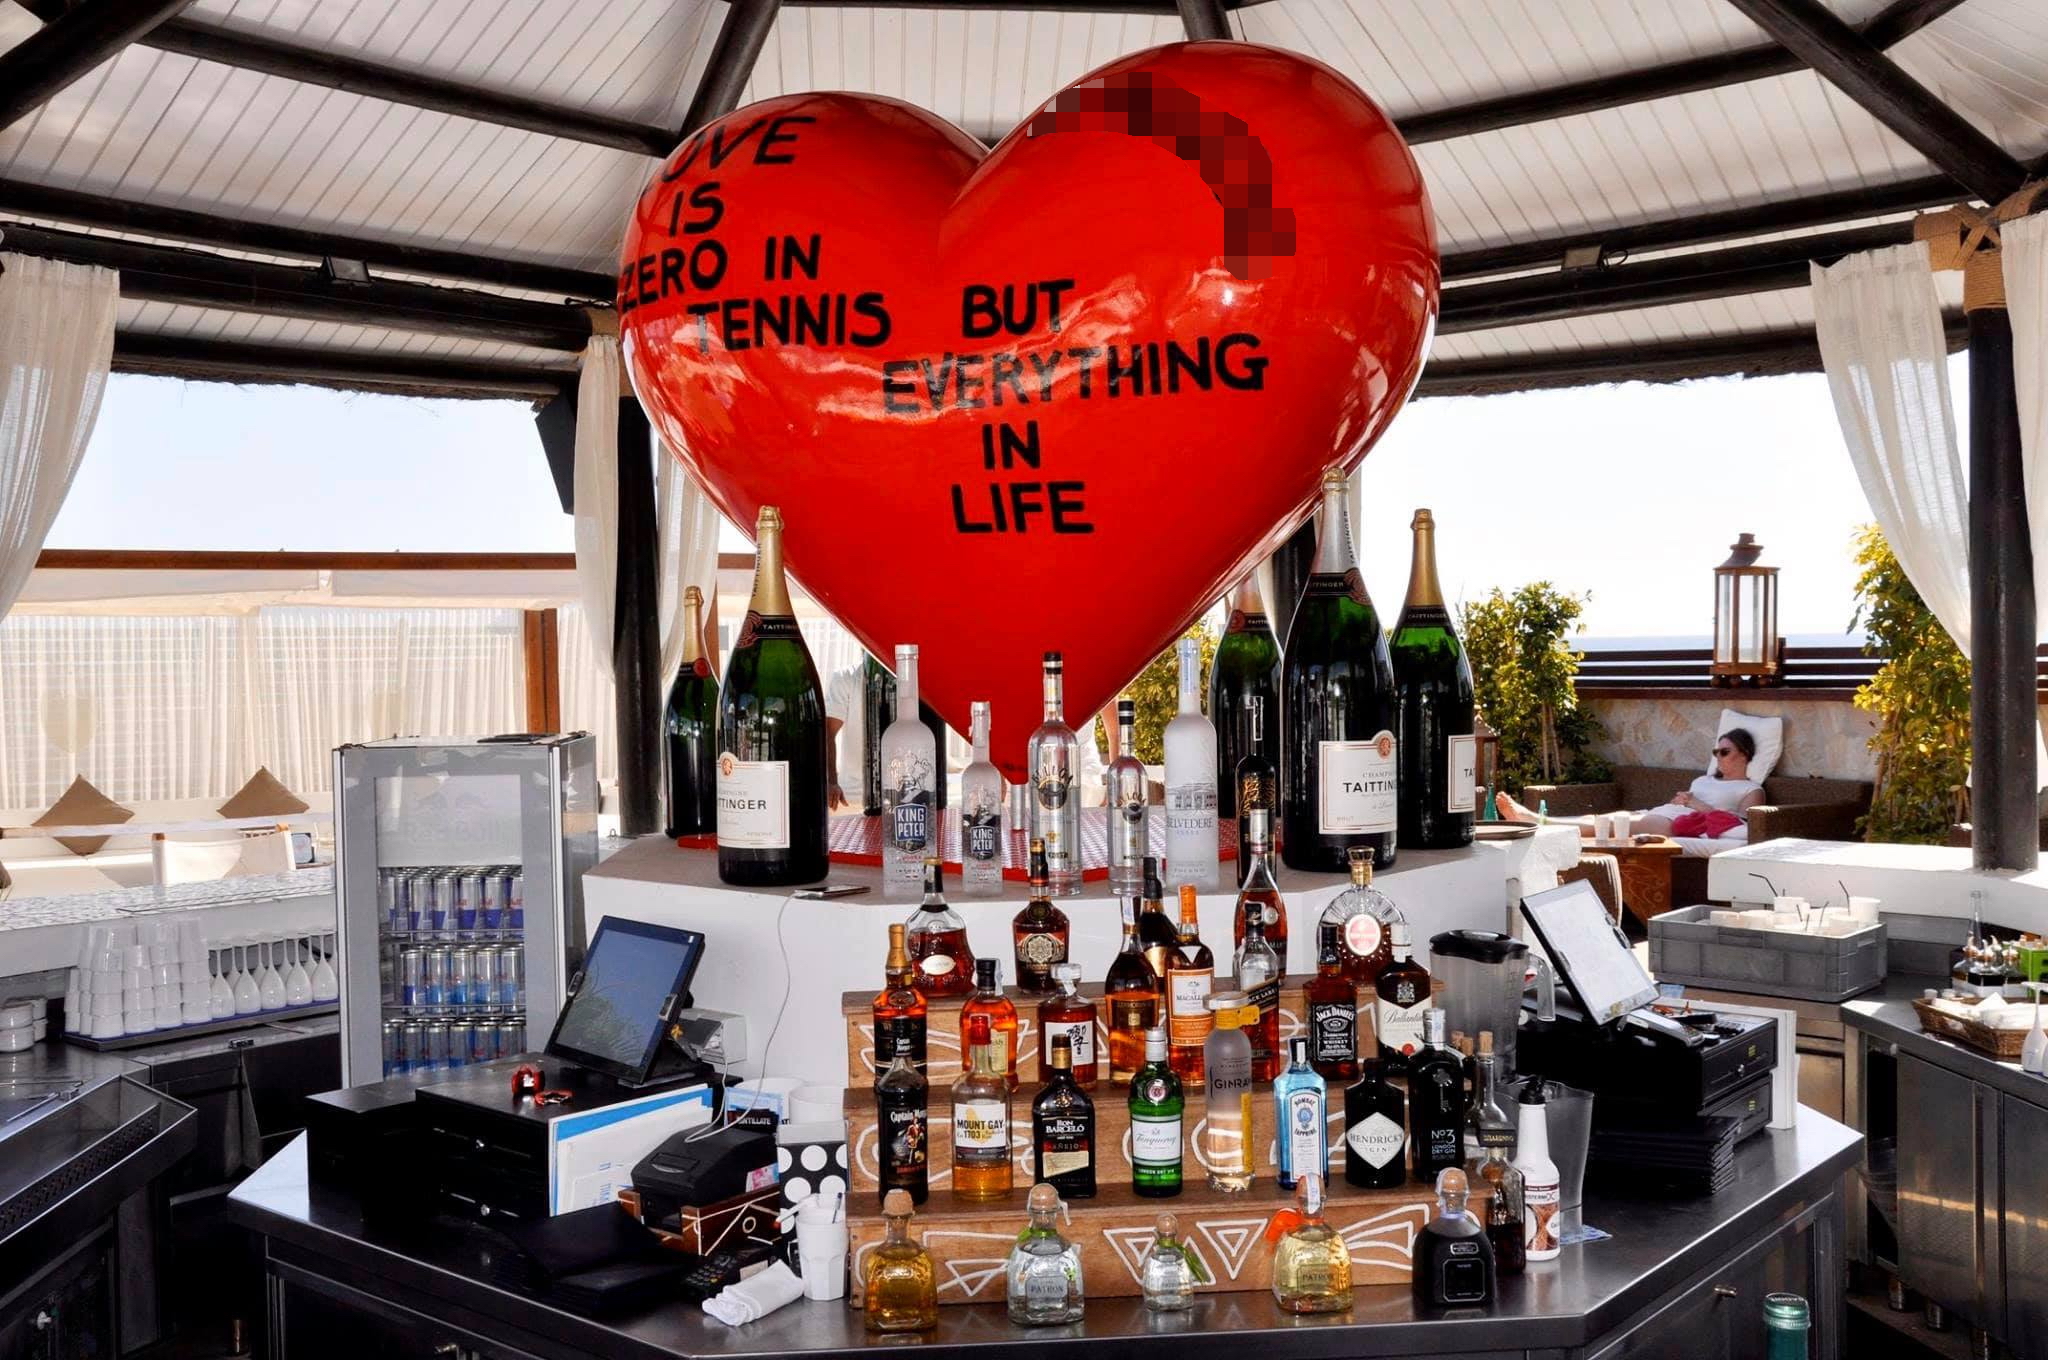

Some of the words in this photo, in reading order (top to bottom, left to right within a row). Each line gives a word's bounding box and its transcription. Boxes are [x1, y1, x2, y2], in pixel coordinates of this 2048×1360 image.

[669, 182, 724, 236] IS
[619, 239, 728, 312] ZERO
[764, 233, 821, 281] IN
[961, 279, 1075, 339] BUT
[686, 291, 891, 353] TENNIS
[883, 332, 1270, 414] EVERYTHING
[981, 420, 1041, 471] IN
[950, 481, 1095, 534] LIFE
[897, 807, 925, 822] KING
[897, 822, 925, 838] PETER
[972, 828, 993, 839] KING
[972, 839, 993, 851] PETER
[1315, 1009, 1332, 1022] JACK
[957, 1119, 985, 1130] MOUNT
[987, 1119, 1004, 1130] GAY
[1045, 1123, 1086, 1134] BARCELÓ
[1056, 1119, 1074, 1127] RON
[963, 1130, 981, 1139] 1703
